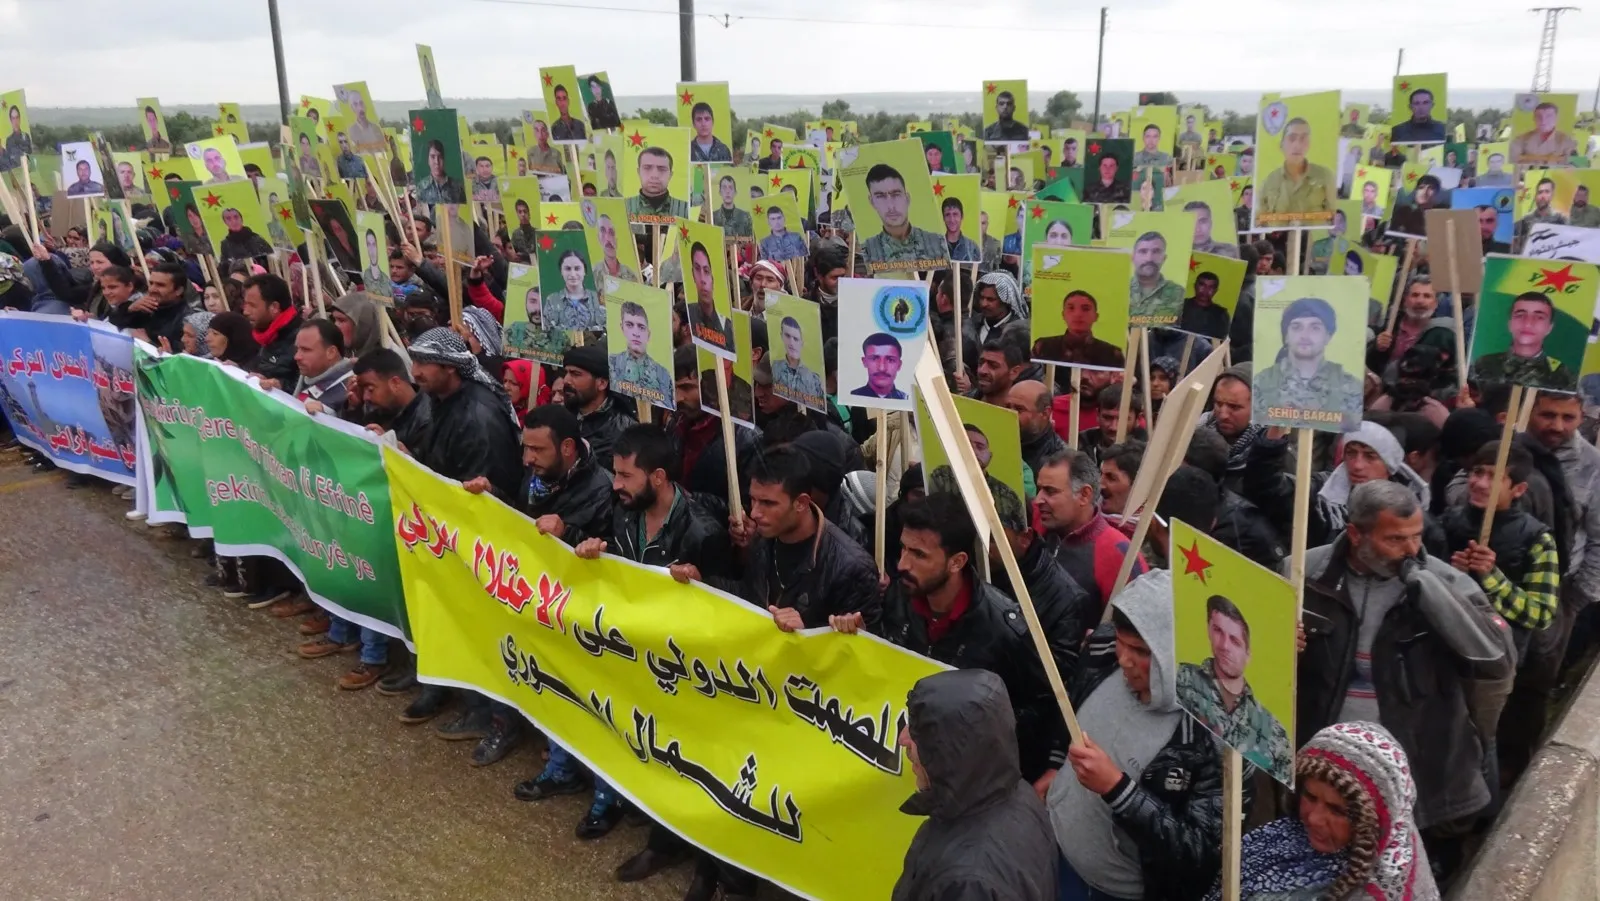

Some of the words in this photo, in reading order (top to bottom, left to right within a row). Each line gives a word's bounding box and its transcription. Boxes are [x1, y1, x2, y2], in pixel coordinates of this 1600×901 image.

[1303, 409, 1342, 422] BARAN
[572, 604, 638, 663] على
[645, 637, 778, 711] الدولي
[624, 706, 803, 844] للشمال
